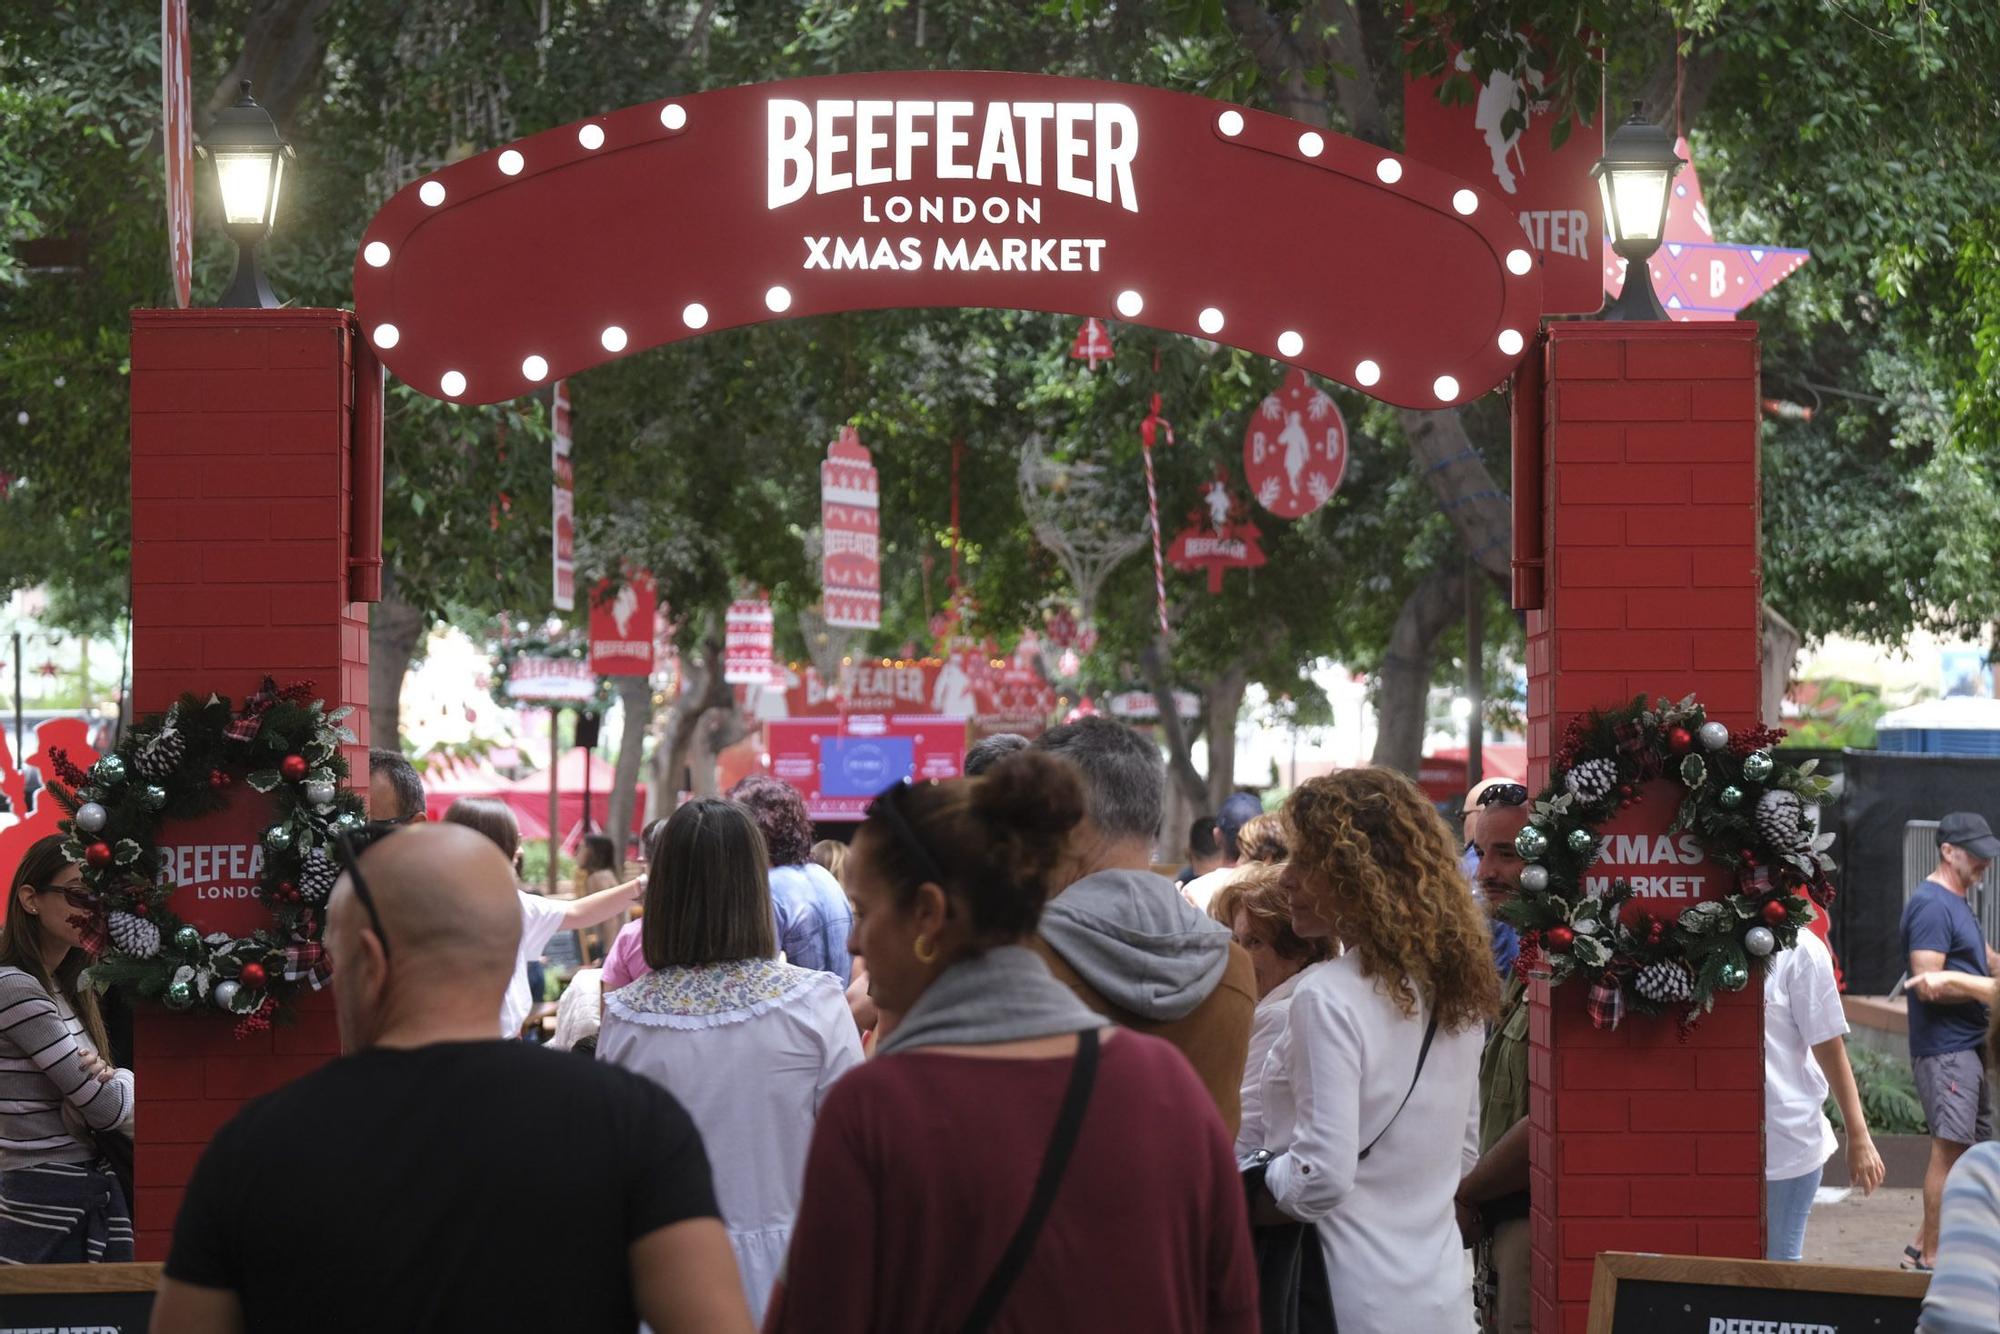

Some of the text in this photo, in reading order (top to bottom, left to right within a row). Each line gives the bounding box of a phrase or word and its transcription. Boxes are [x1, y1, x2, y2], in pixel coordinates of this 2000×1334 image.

[768, 99, 1139, 213] BEEFEATER
[863, 195, 1041, 224] LONDON
[803, 236, 1106, 271] XMAS MARKET
[1709, 259, 1726, 298] B
[1252, 431, 1266, 464] B
[1325, 427, 1339, 461] B
[1595, 834, 1704, 865] XMAS
[1586, 876, 1706, 898] MRKET
